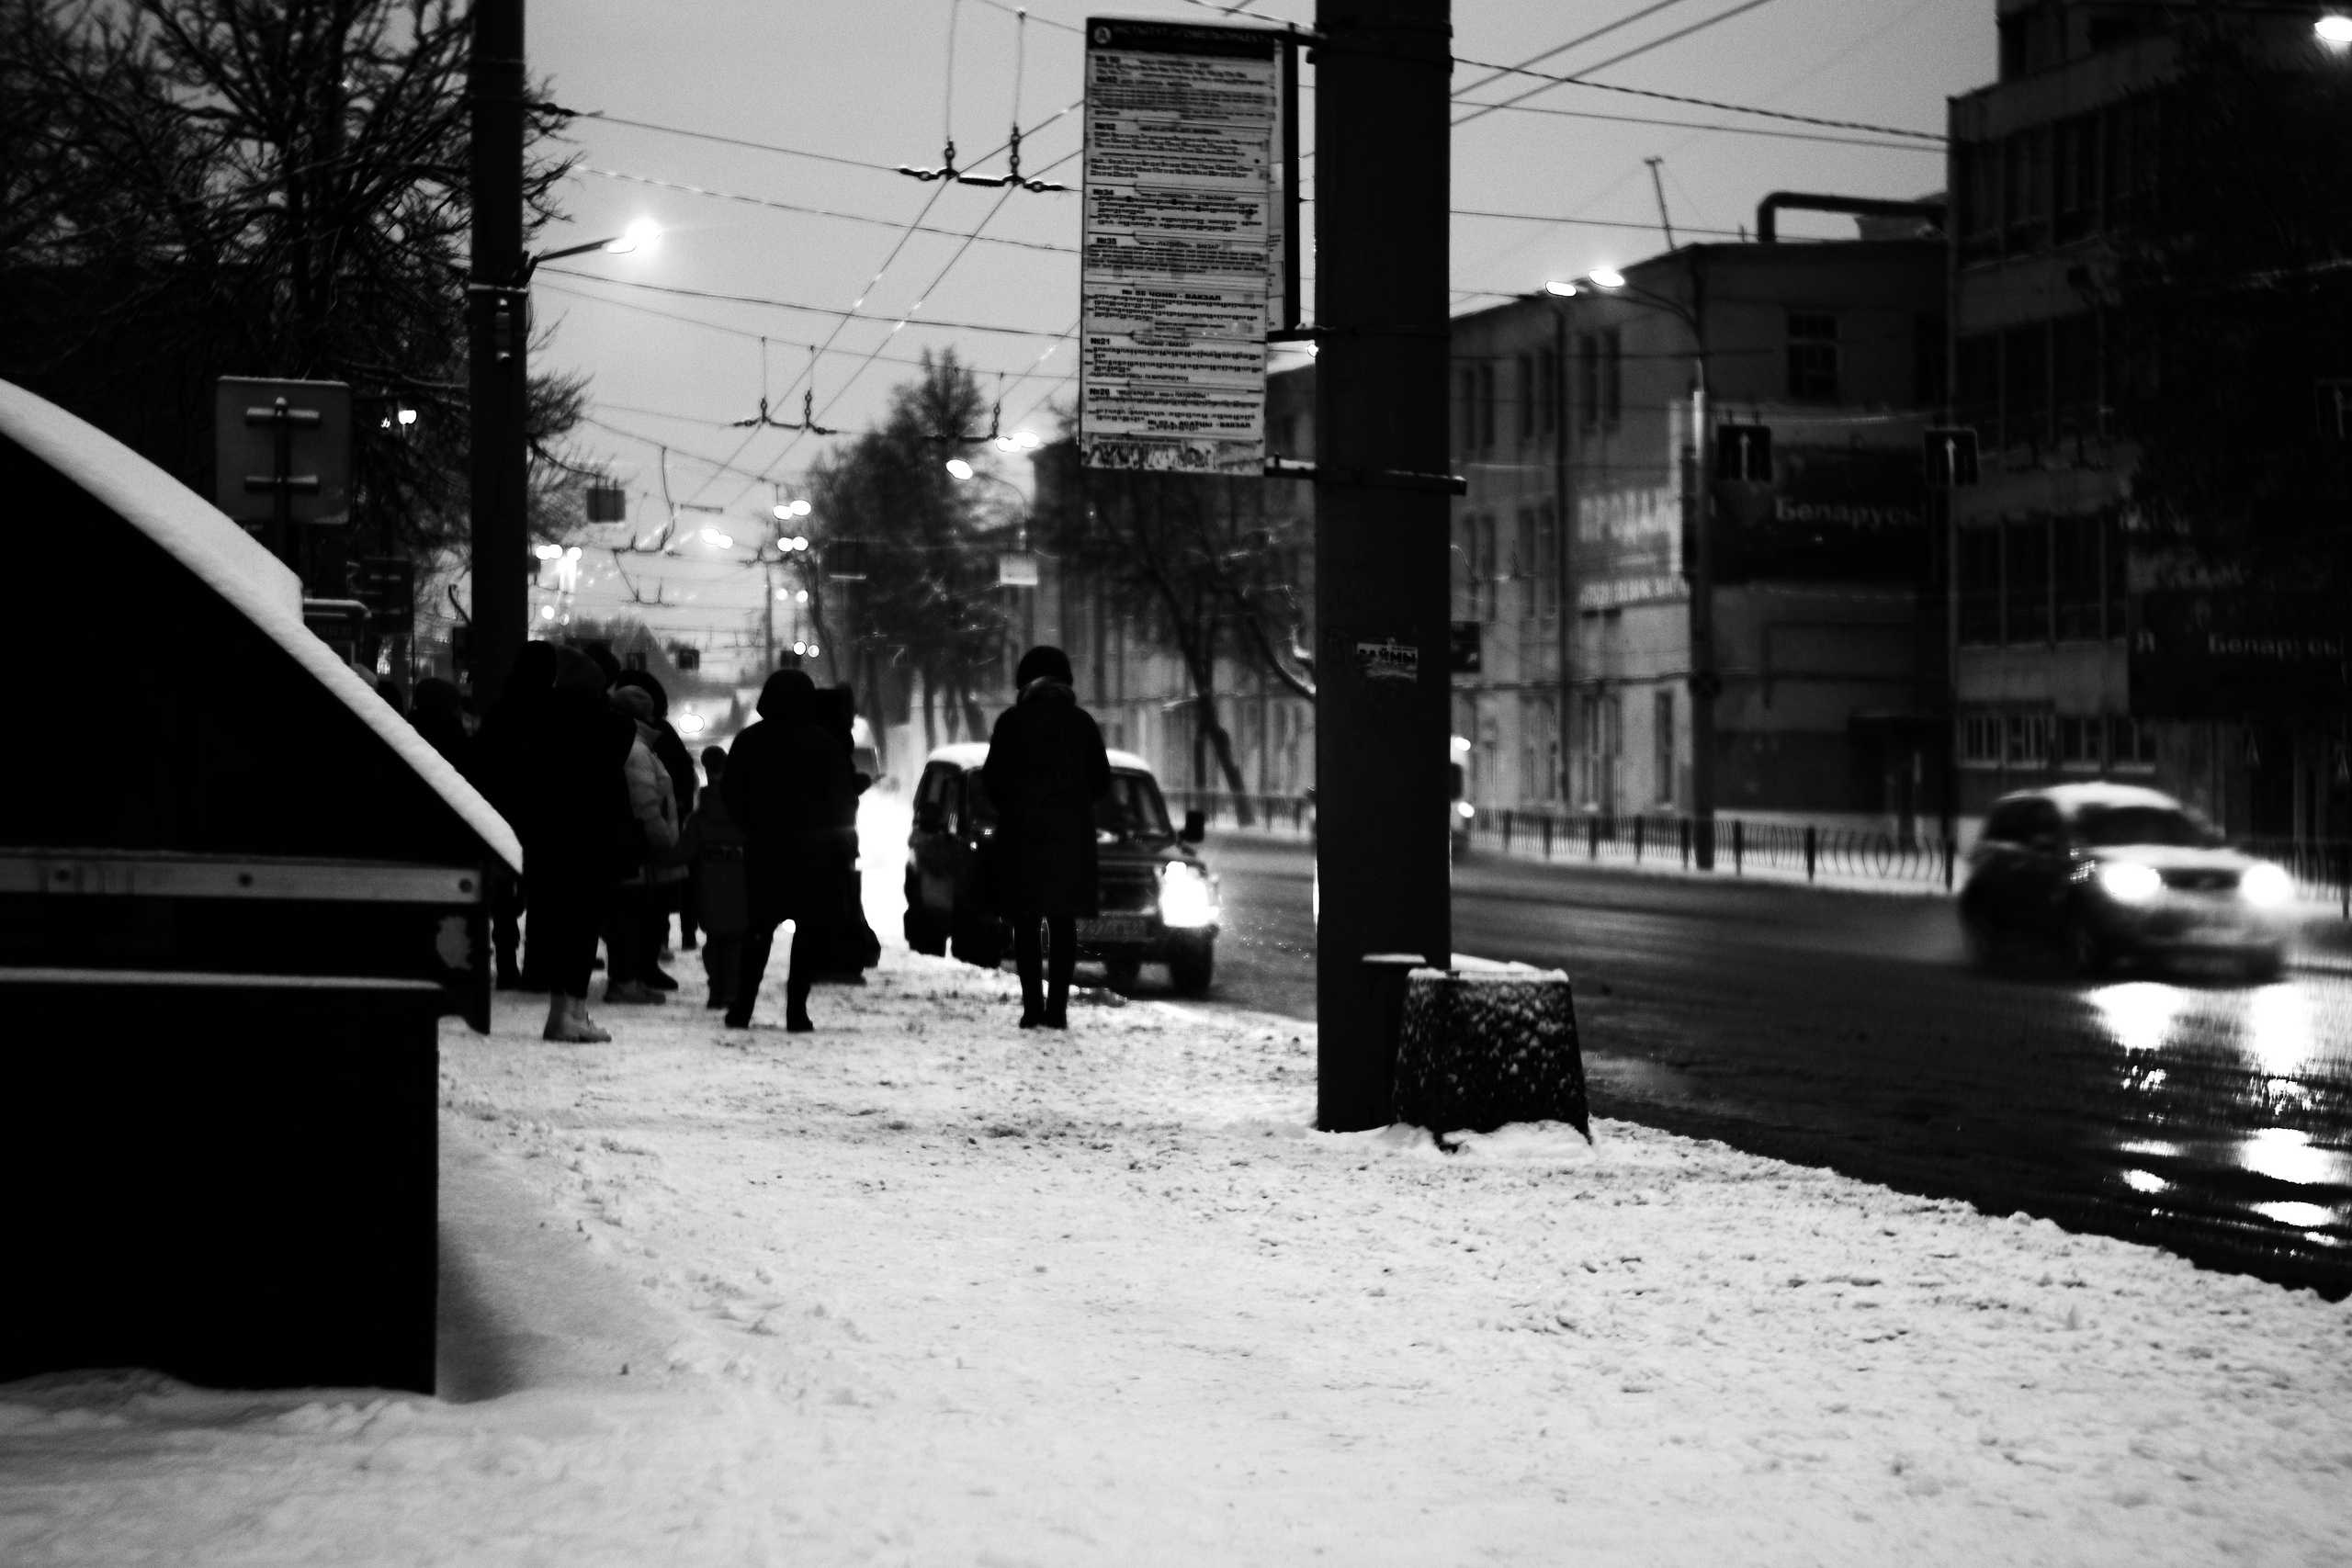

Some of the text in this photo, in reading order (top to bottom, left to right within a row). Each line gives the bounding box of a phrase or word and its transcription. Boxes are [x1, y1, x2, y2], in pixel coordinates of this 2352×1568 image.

[1093, 188, 1114, 197] №34
[1096, 237, 1117, 245] №35
[1184, 293, 1222, 301] ВАКЗАЛ
[1091, 337, 1110, 345] №21
[1090, 388, 1110, 396] №26
[2136, 631, 2155, 653] Я
